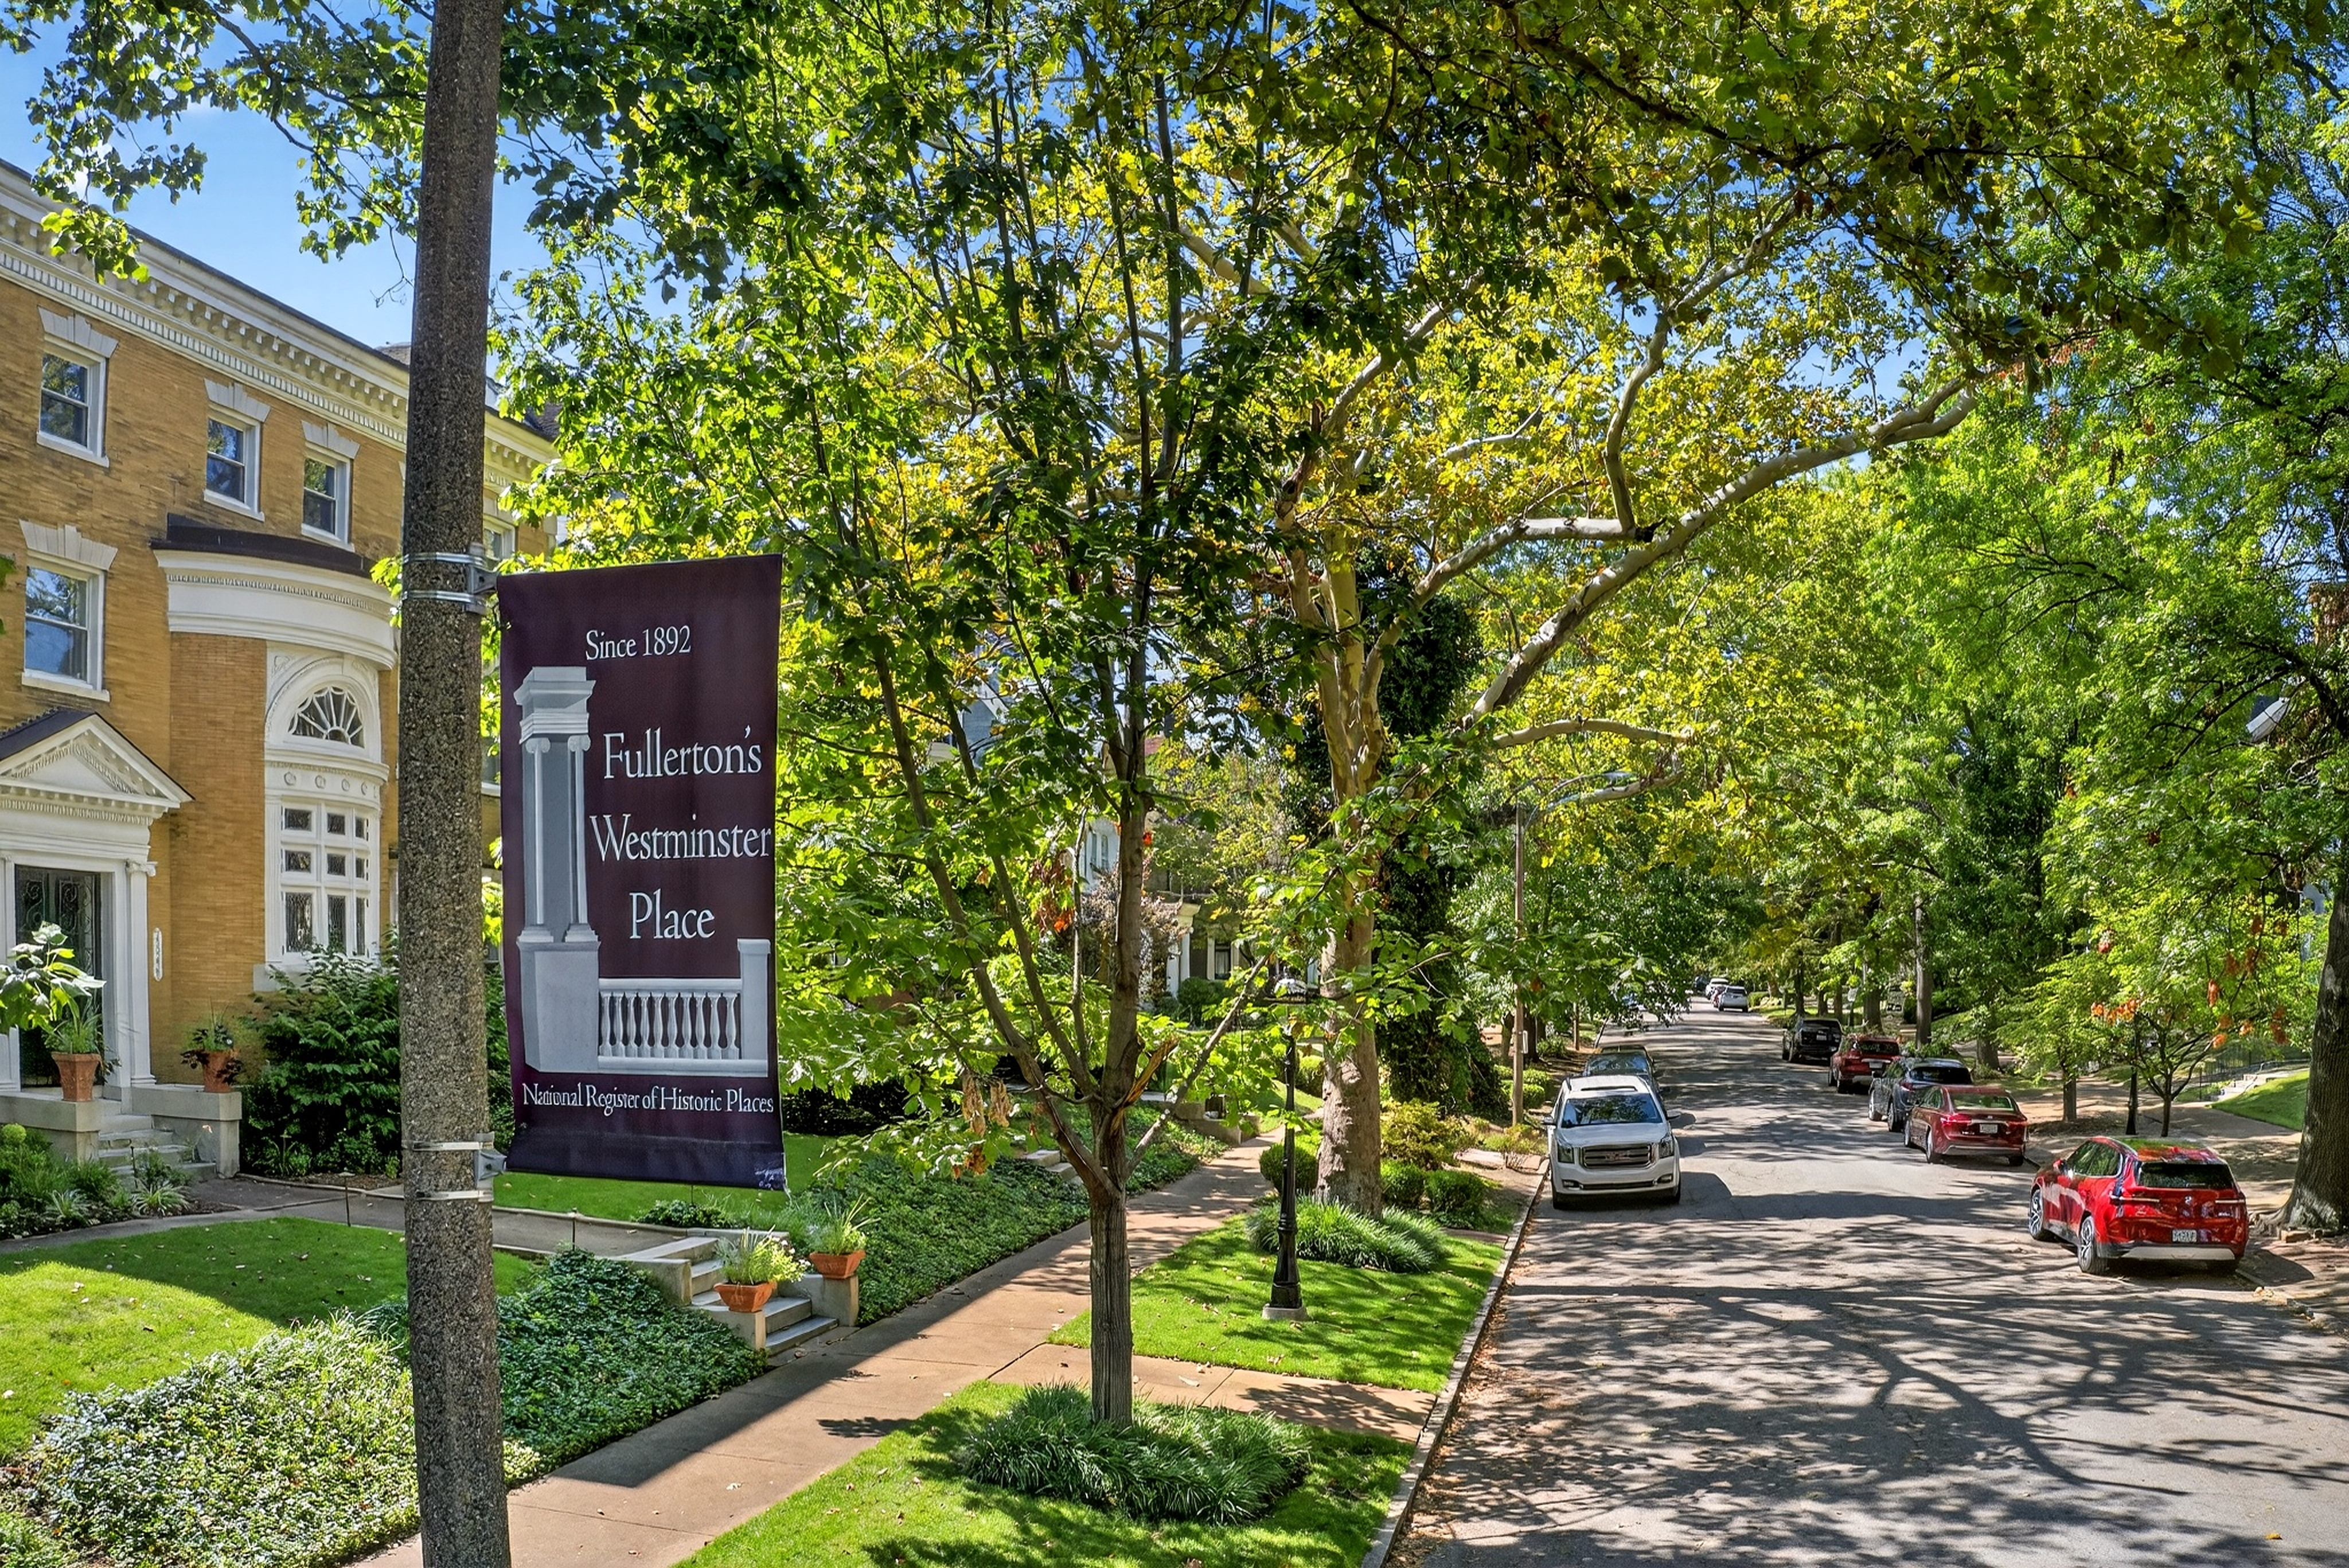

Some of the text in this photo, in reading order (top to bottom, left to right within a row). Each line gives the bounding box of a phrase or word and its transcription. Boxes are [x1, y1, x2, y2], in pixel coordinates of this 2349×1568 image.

[585, 625, 692, 661] Since 1892
[603, 724, 762, 779] Fullerton's
[588, 813, 771, 862] Westminster
[629, 888, 716, 939] Place
[522, 1083, 774, 1117] National Register of Historic Places
